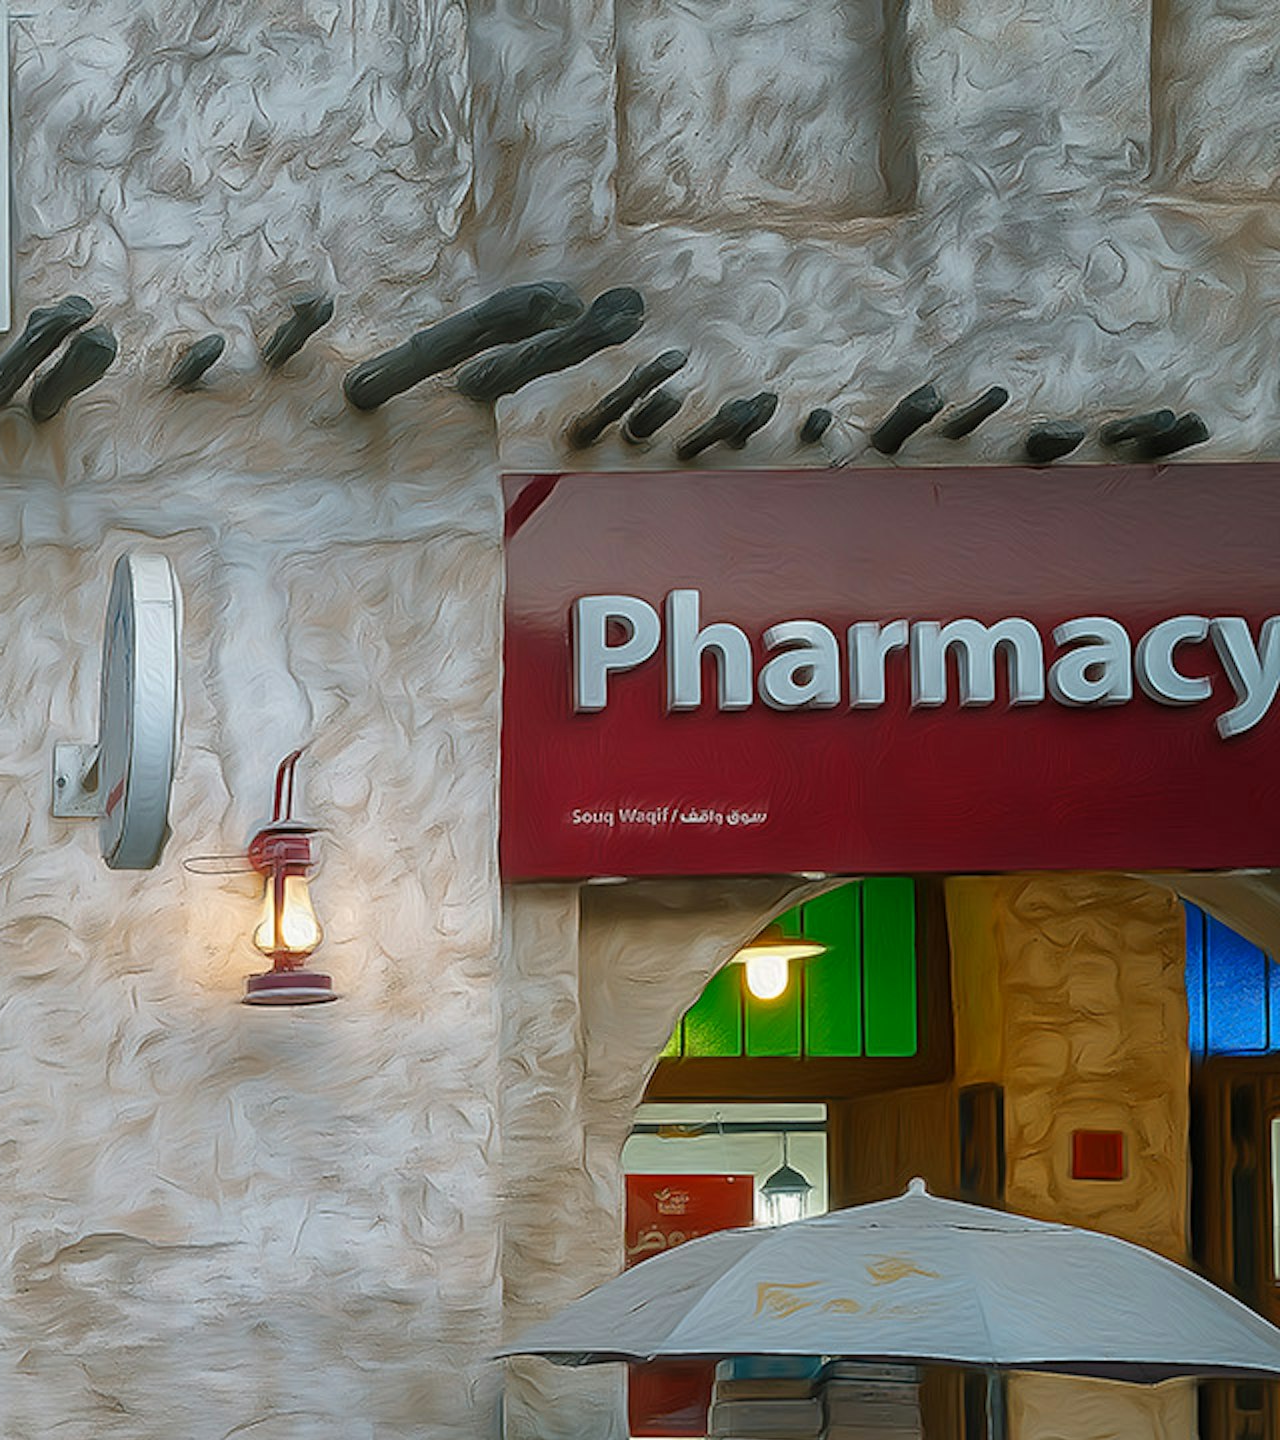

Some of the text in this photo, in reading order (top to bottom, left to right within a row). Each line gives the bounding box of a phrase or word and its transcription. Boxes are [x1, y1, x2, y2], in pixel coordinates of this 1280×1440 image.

[571, 588, 1280, 741] Pharmacy
[571, 808, 615, 828] Souq
[618, 806, 670, 827] Waqif
[680, 806, 724, 827] واقف
[725, 808, 768, 827] سوق
